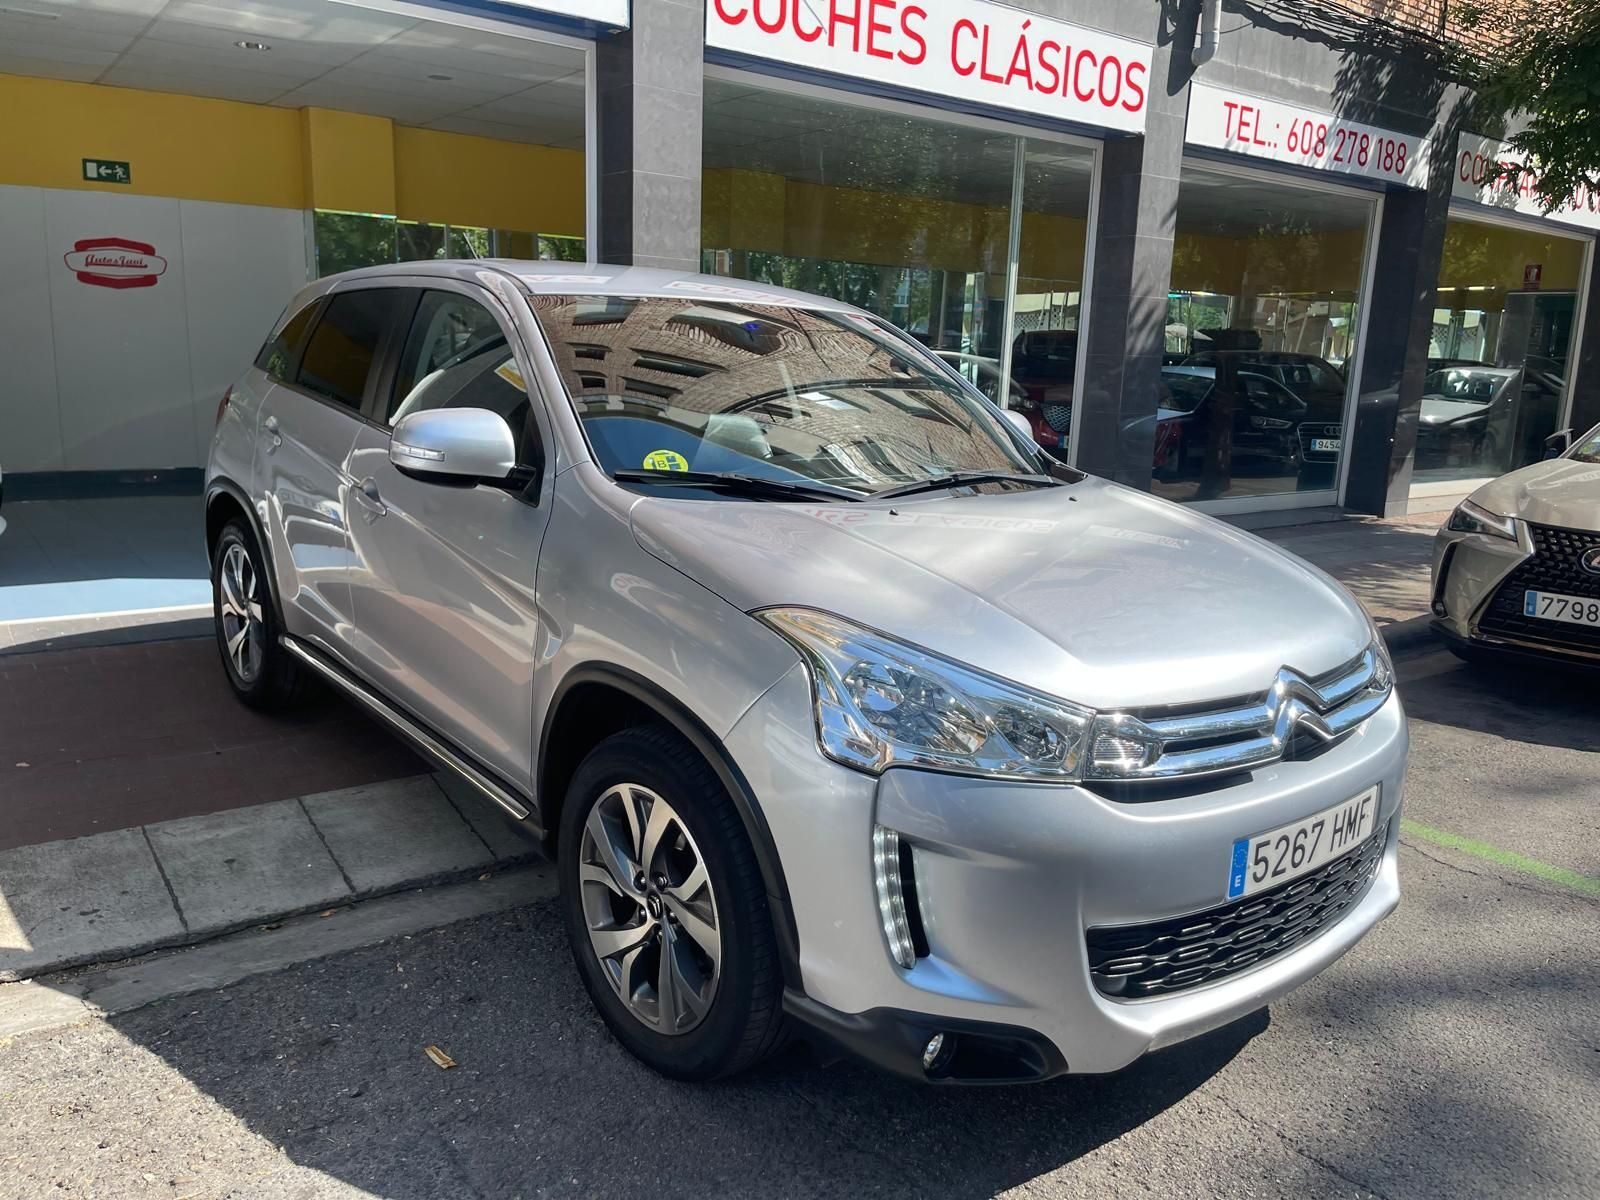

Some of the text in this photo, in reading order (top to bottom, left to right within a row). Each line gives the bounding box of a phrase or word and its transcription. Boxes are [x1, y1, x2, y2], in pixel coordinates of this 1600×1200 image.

[951, 19, 1146, 112] CLÁSICOS
[1223, 101, 1407, 174] TEL.: 608 278 188
[1541, 596, 1599, 622] 7798
[1234, 795, 1372, 887] E 5267 HMF
